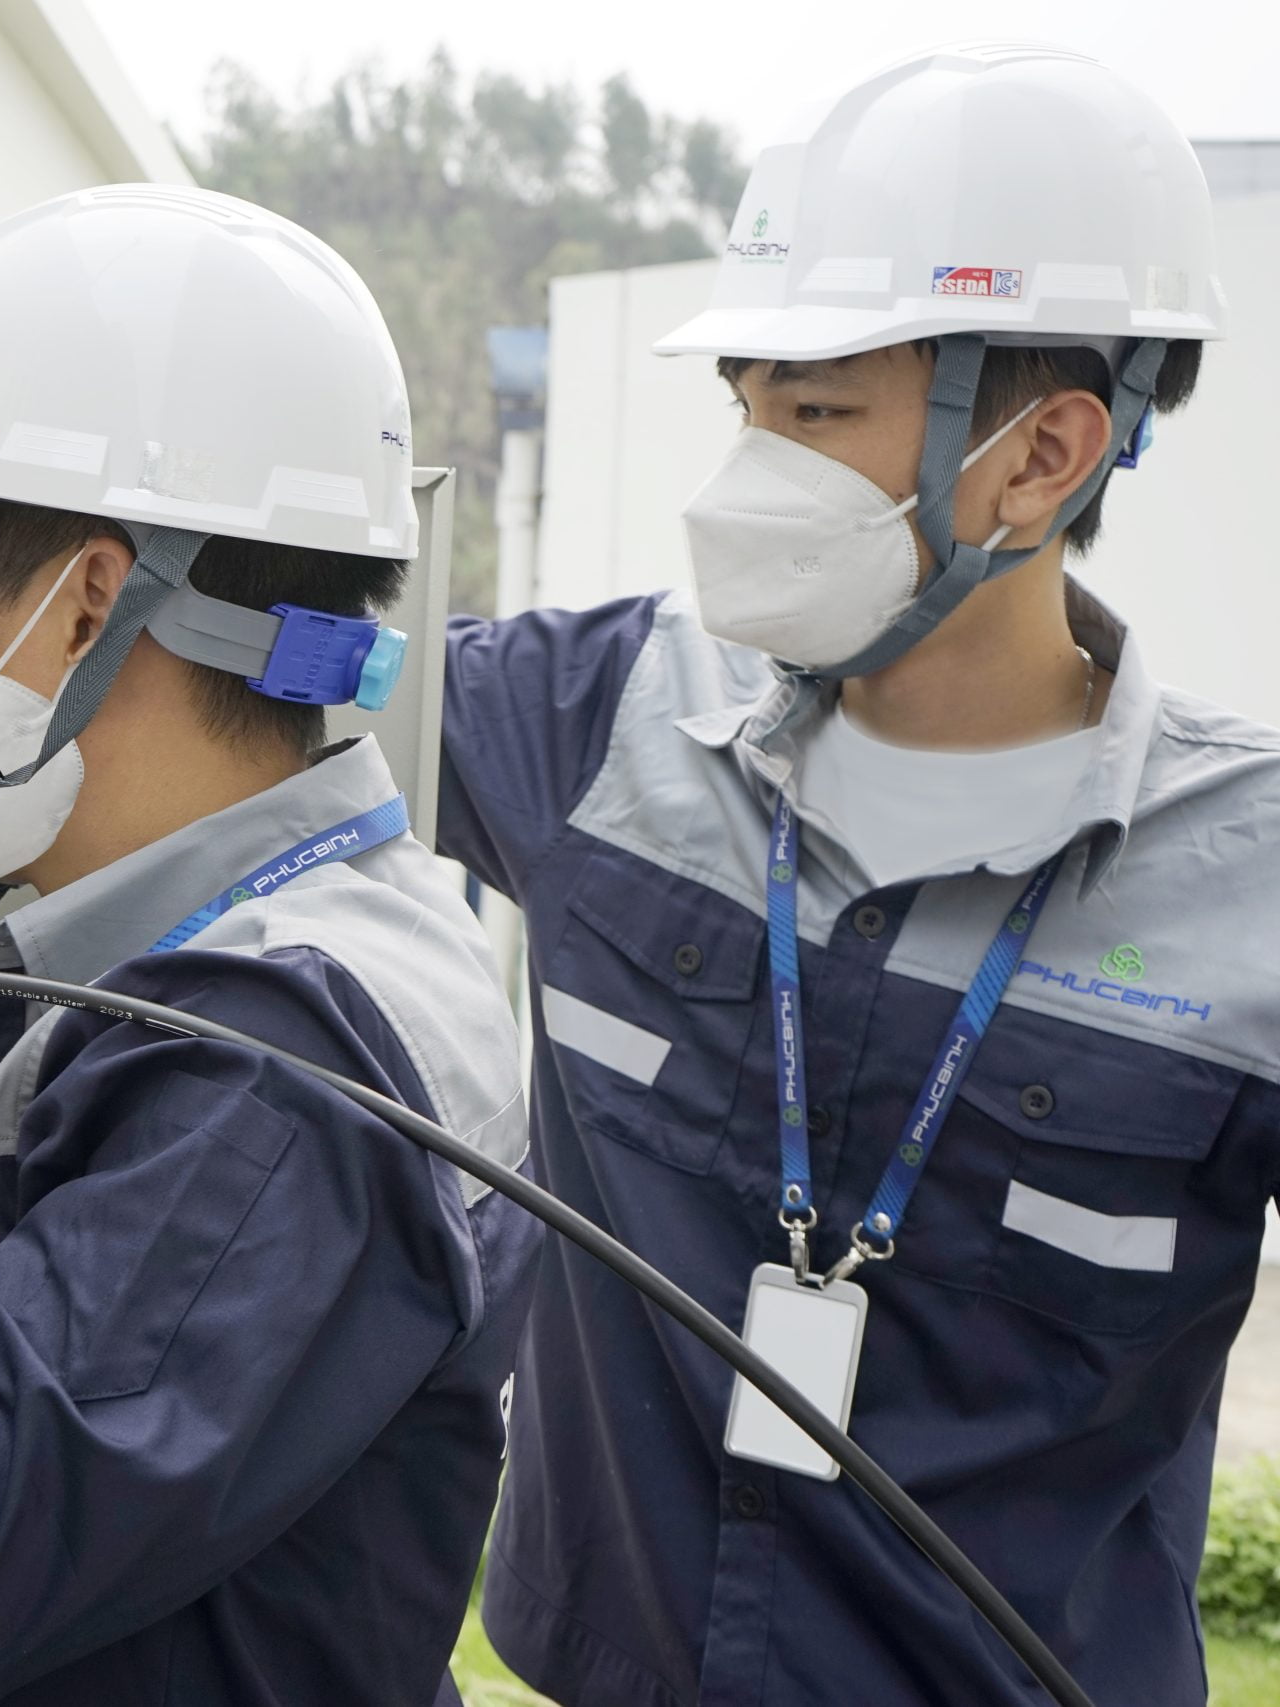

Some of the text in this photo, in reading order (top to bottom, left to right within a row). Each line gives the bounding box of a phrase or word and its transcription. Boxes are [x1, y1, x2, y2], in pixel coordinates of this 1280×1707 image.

[932, 278, 989, 296] SSEDA
[792, 555, 823, 576] N95
[252, 828, 360, 893] PHUCBINH
[16, 990, 40, 1000] Cable
[98, 1005, 133, 1020] 2023
[1016, 960, 1212, 1021] PHUCBINH
[784, 991, 797, 1103] PHUCBINH
[912, 1034, 968, 1144] PHUCBINH
